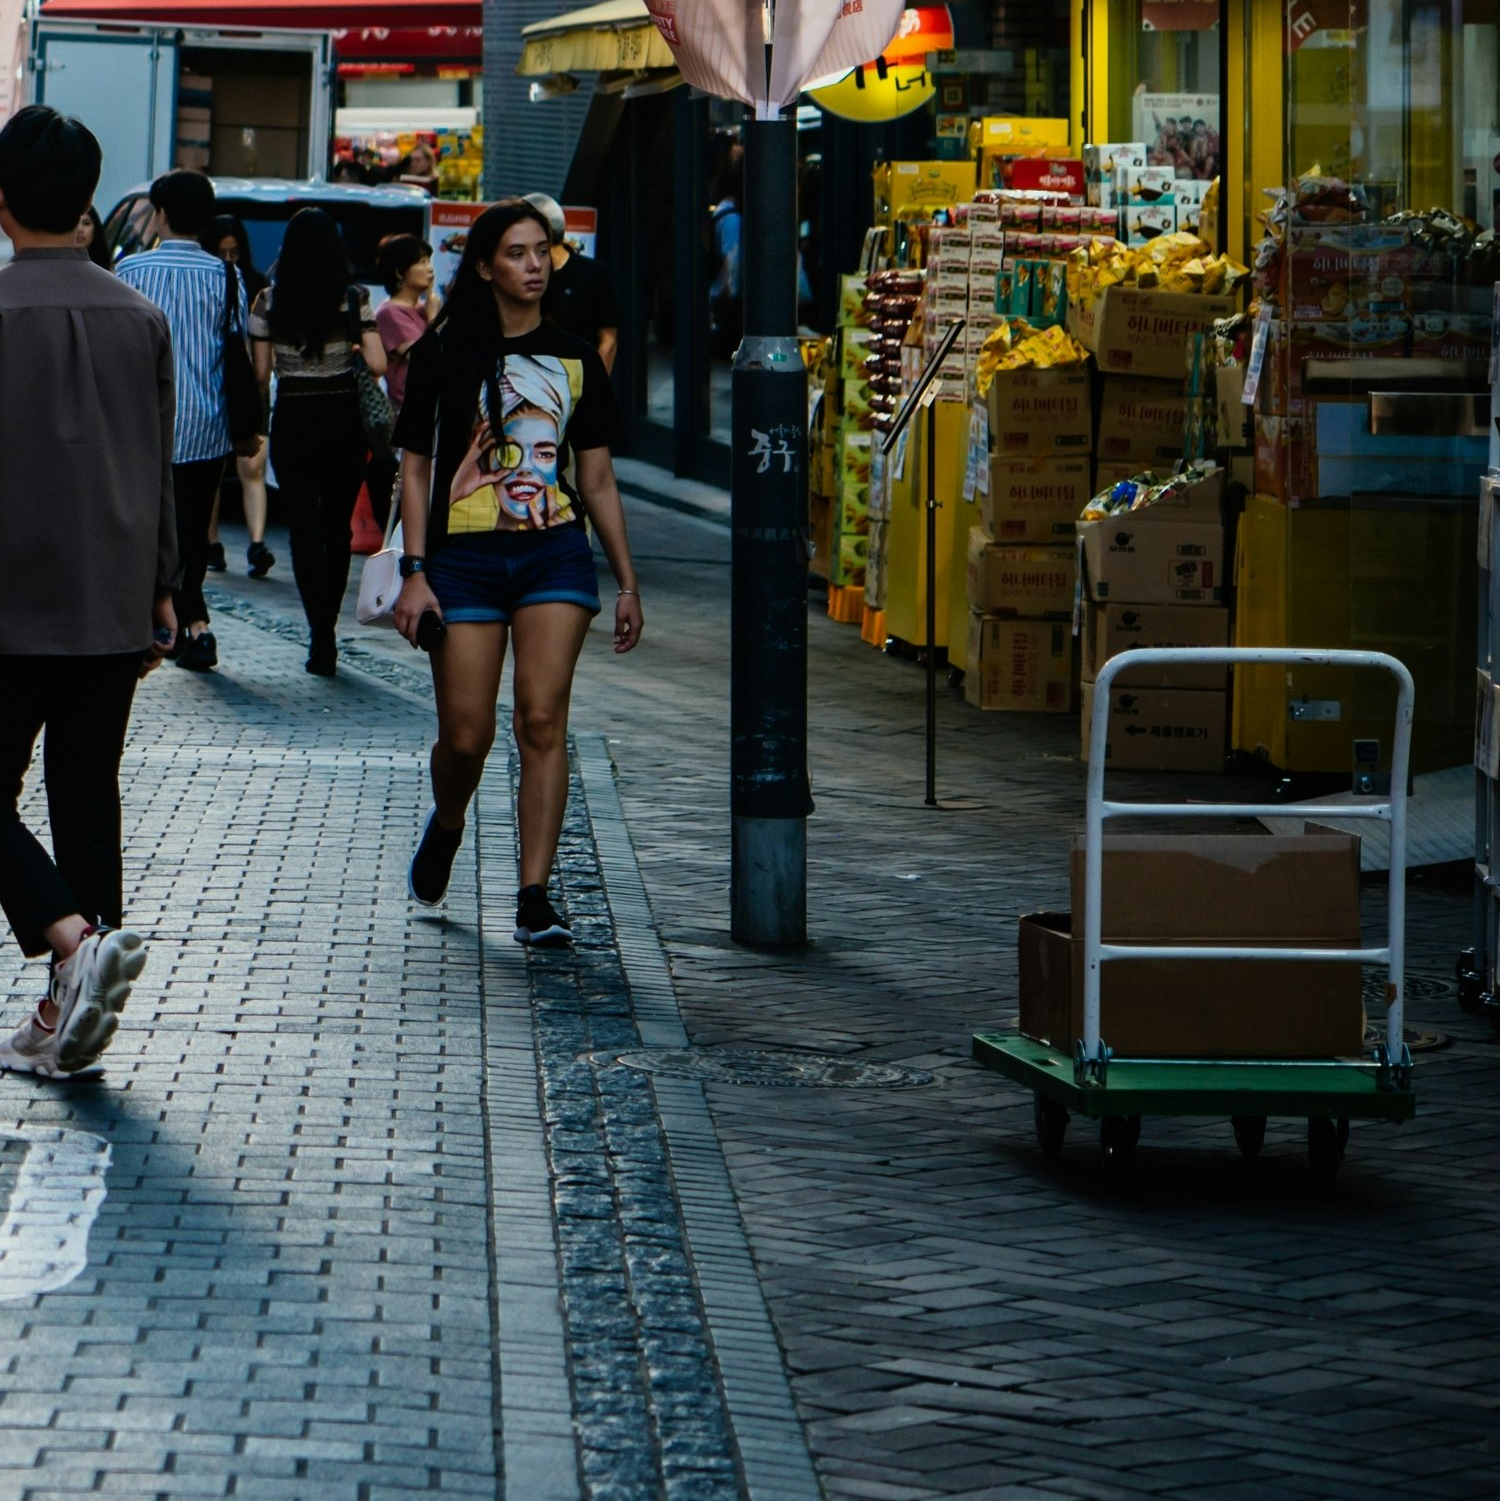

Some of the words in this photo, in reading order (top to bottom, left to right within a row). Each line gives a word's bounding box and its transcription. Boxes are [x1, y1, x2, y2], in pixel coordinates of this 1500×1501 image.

[1012, 396, 1079, 414] 허니버터칩
[1117, 403, 1187, 423] 허니버터칩
[746, 428, 798, 475] 중구
[1009, 484, 1075, 502] 허니버터칩
[1000, 572, 1067, 589] 허니버터칩
[1012, 633, 1028, 697] 허니버터칩
